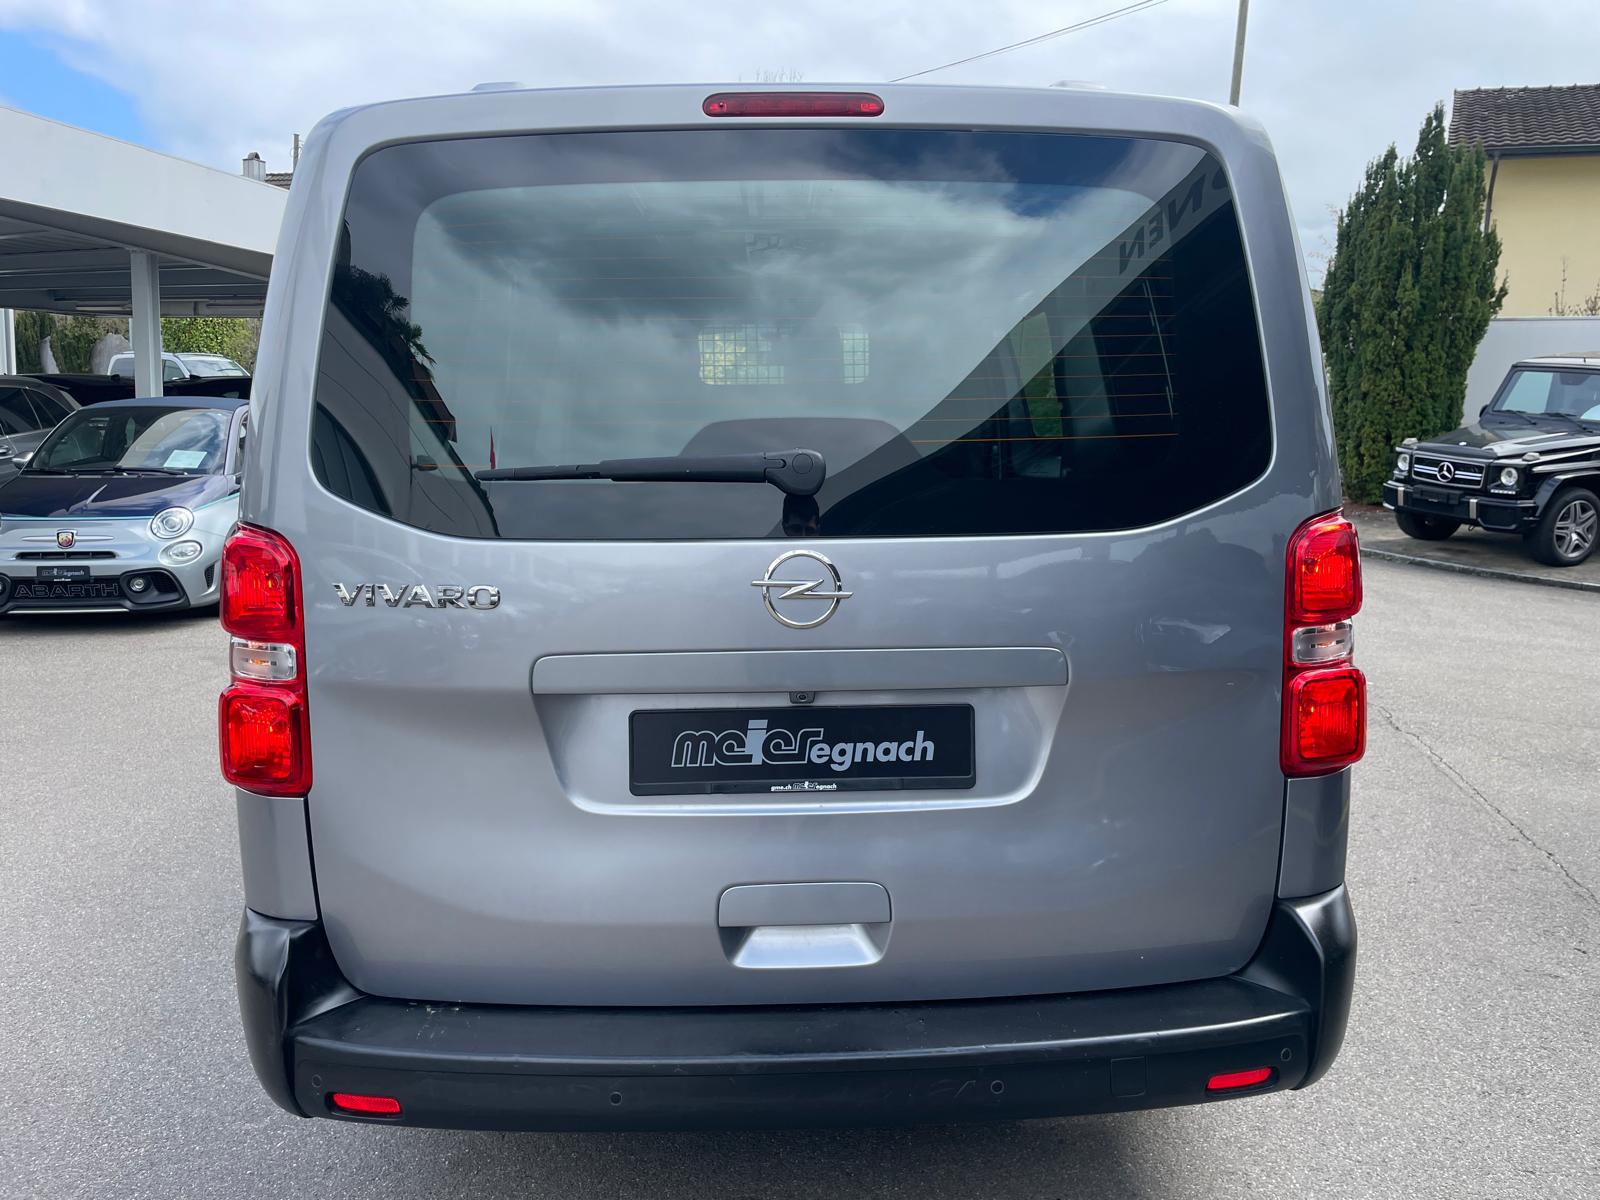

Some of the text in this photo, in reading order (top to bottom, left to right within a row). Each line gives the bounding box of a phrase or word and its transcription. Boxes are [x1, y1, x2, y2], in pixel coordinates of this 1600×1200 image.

[15, 583, 119, 598] ABARTH
[332, 582, 501, 610] VIVARO
[810, 731, 935, 772] egnach
